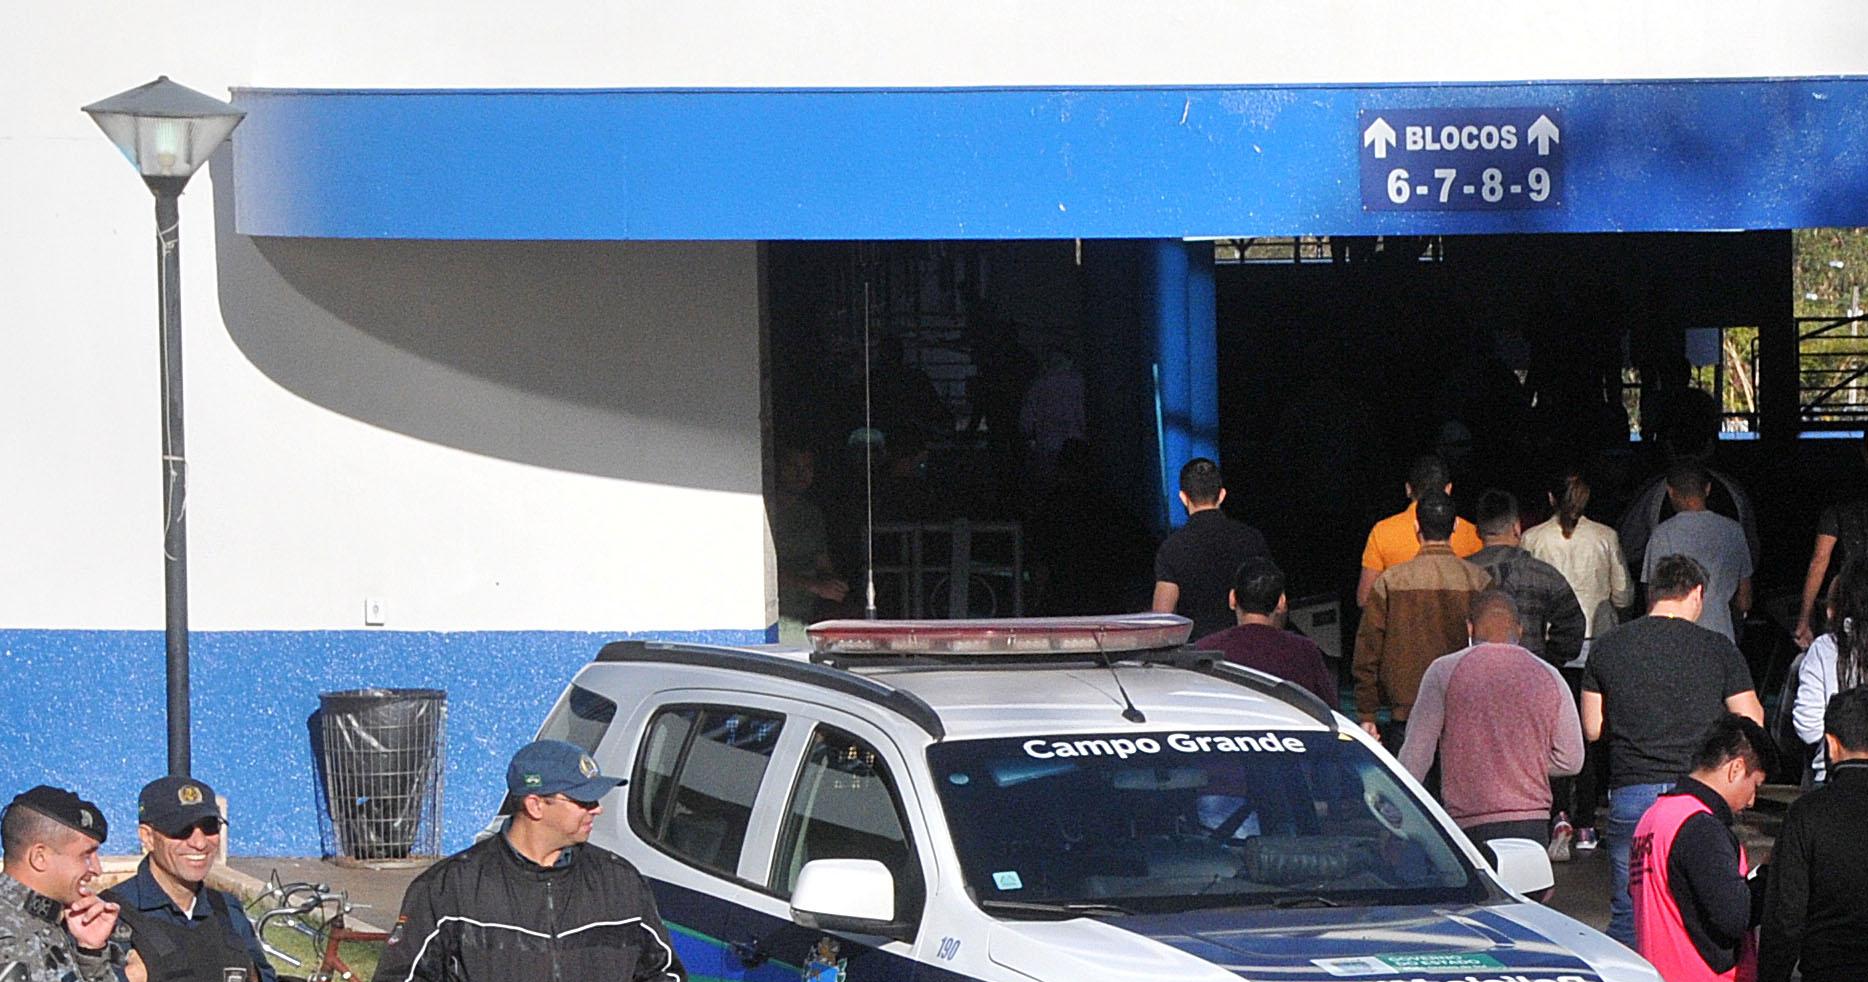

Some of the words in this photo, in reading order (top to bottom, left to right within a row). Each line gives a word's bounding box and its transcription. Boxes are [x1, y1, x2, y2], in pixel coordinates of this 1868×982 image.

[1405, 125, 1518, 151] BLOCOS
[1023, 737, 1161, 759] Campo
[1167, 732, 1307, 754] Grande
[936, 936, 961, 961] 190
